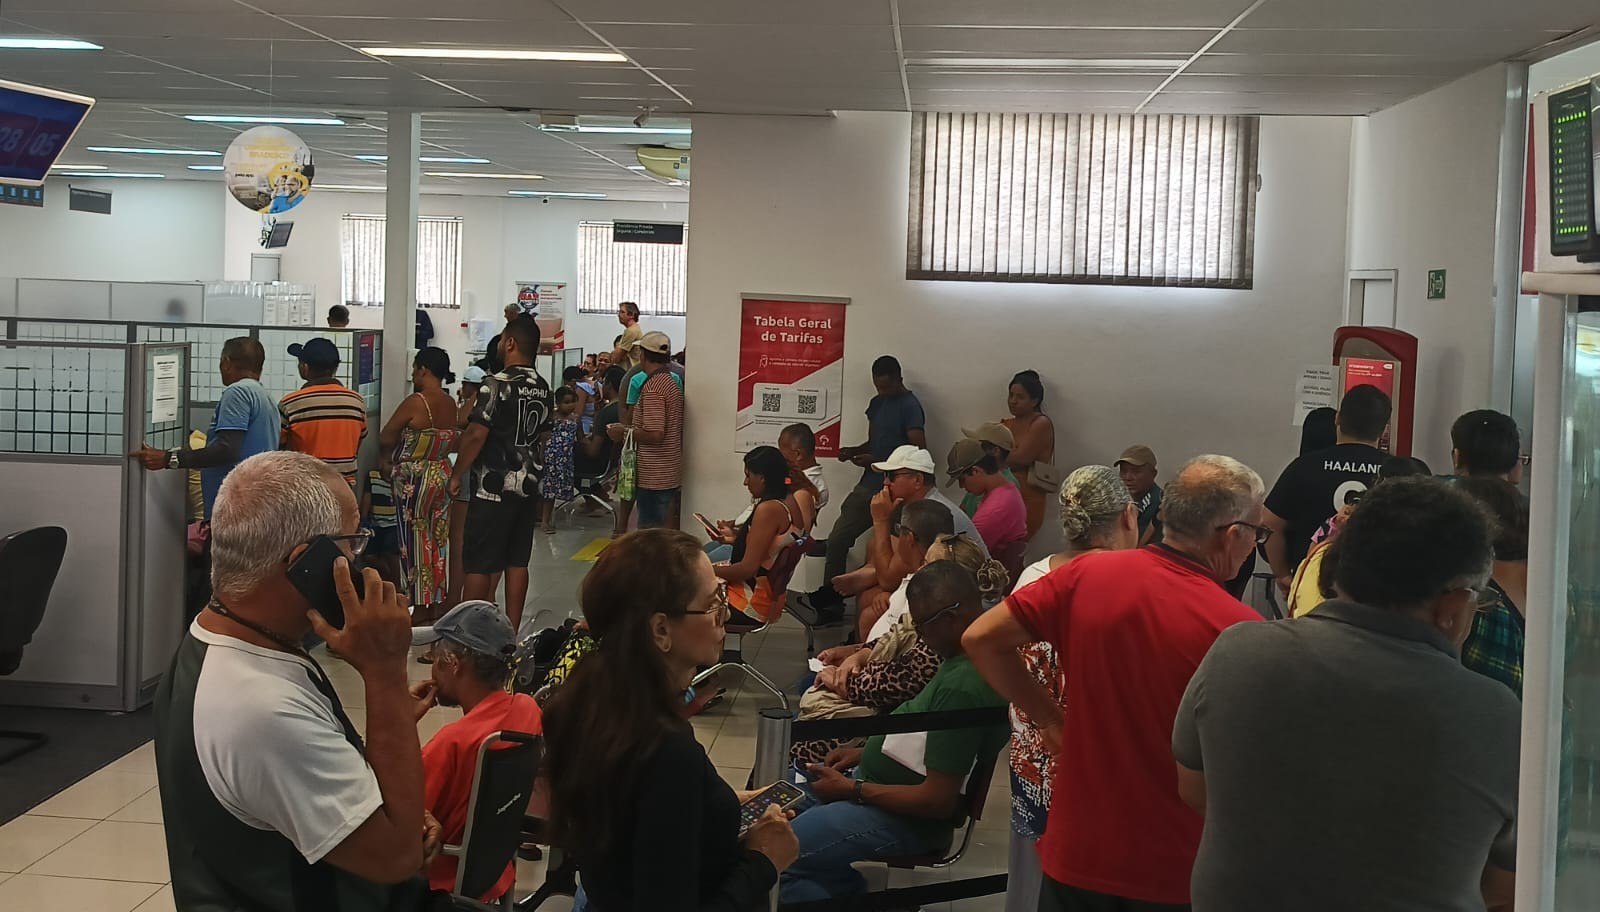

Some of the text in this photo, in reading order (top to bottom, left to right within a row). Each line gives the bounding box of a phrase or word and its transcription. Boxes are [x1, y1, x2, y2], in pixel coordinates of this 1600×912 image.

[753, 315, 832, 329] Tabela Geral
[761, 331, 823, 344] de Tarifas
